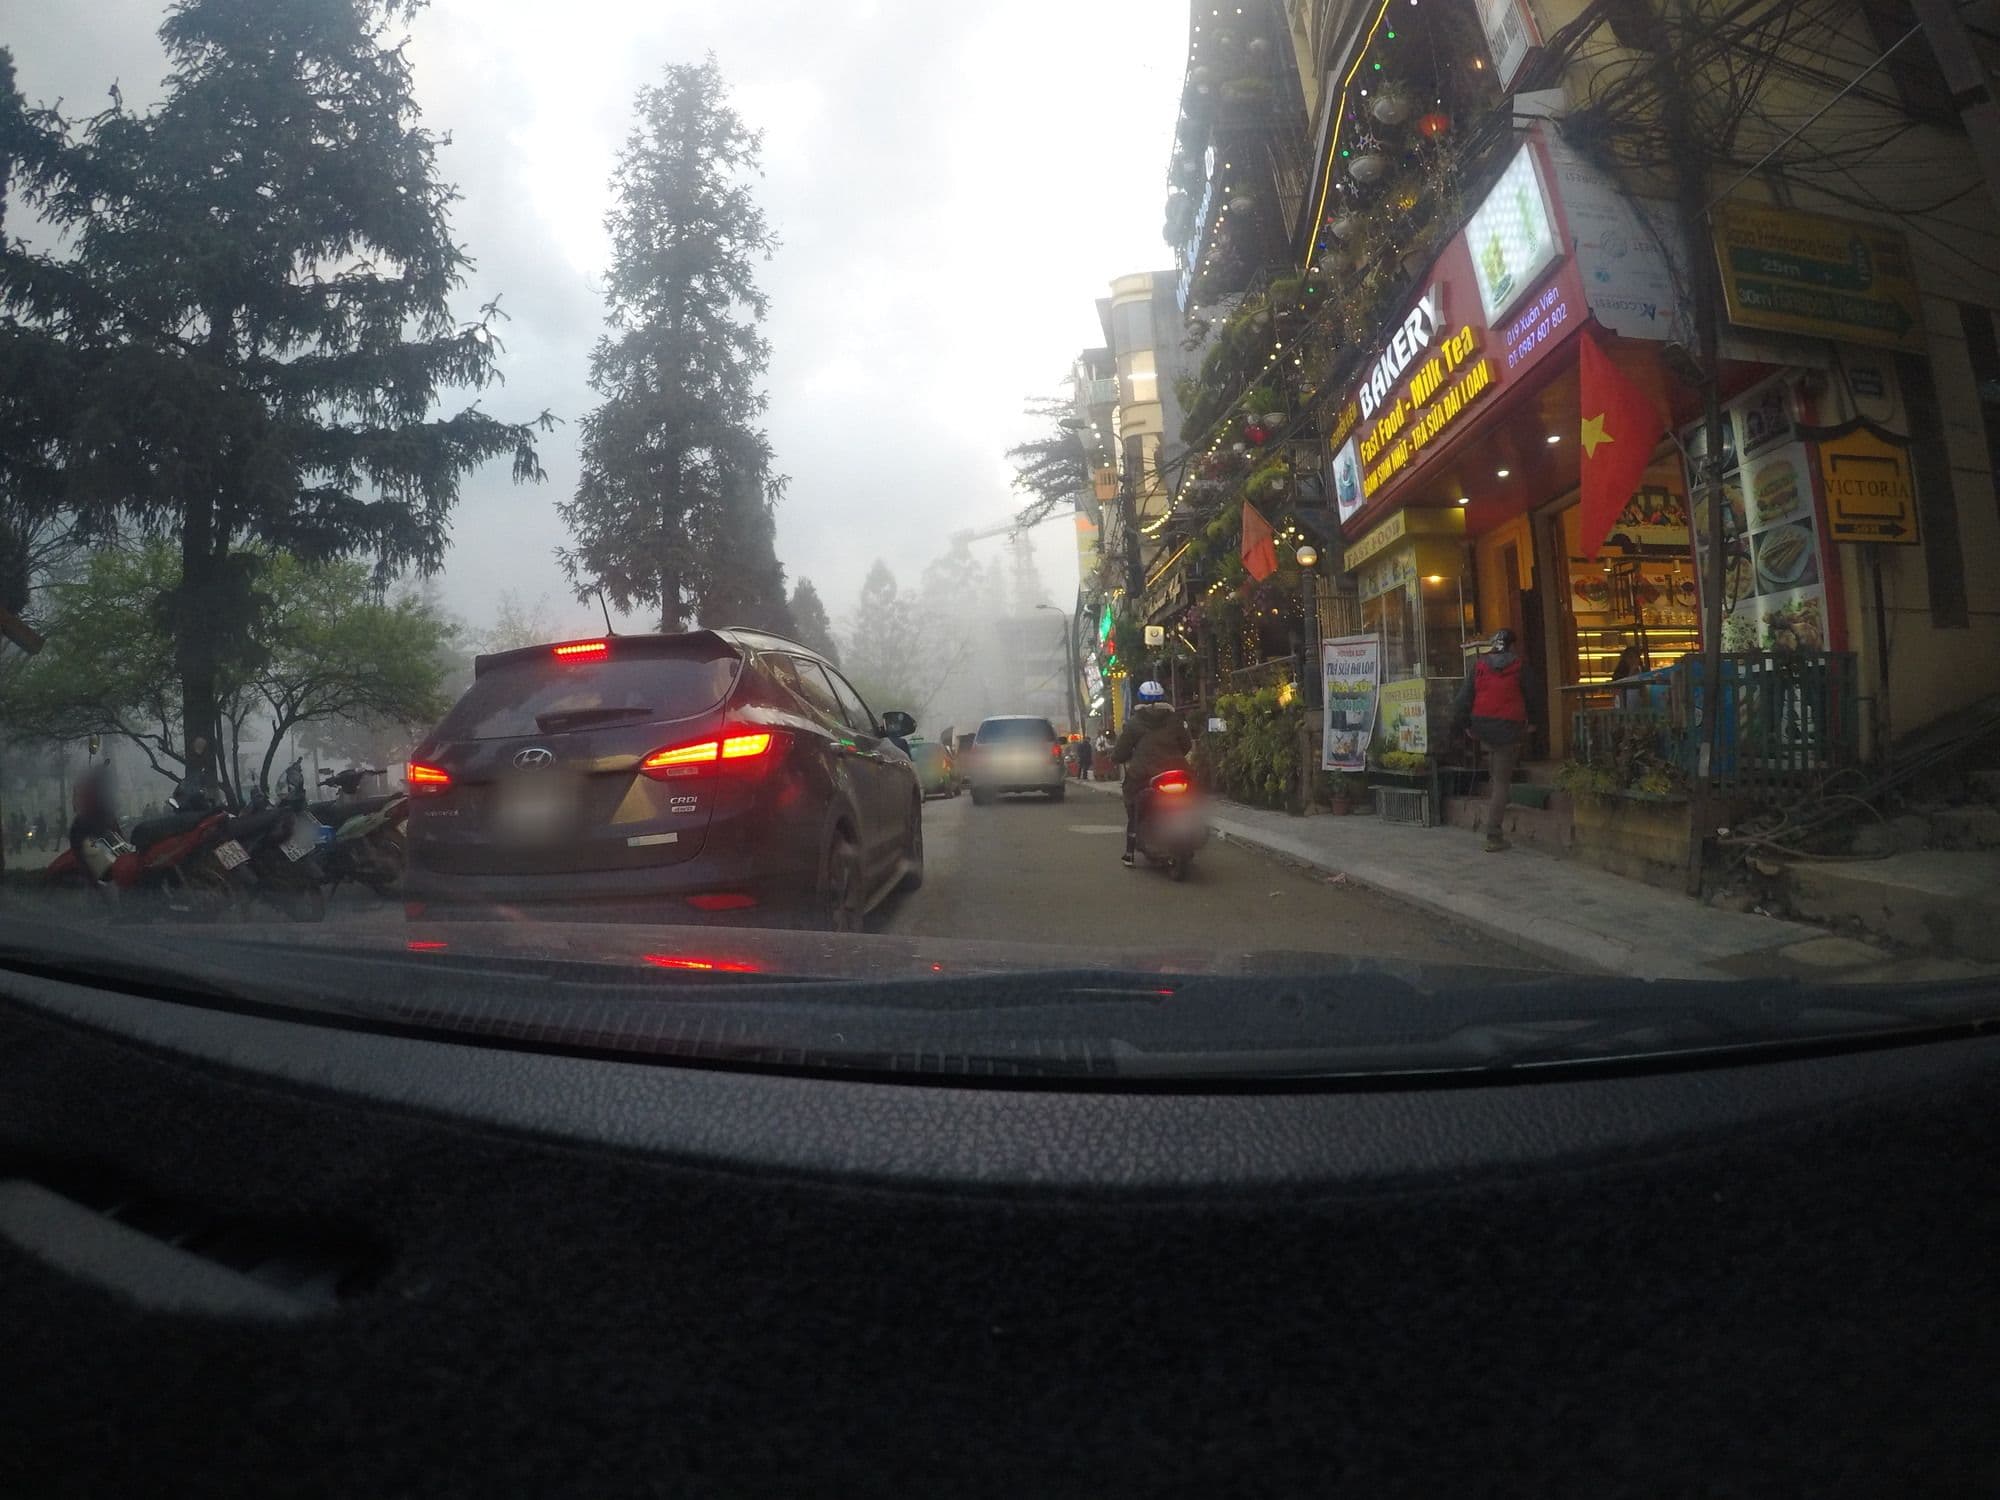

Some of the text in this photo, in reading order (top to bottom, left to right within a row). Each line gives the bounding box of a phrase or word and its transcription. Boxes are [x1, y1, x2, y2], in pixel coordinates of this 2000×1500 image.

[1359, 282, 1444, 420] BAKERY
[1506, 323, 1520, 346] 019
[1518, 331, 1535, 359] 0987
[1537, 317, 1550, 343] 607
[1551, 303, 1568, 328] 802
[1360, 428, 1380, 466] Fast
[1377, 398, 1405, 446] Food
[1409, 358, 1444, 410] Milk
[1441, 325, 1475, 373] Tea
[1411, 416, 1429, 451] TRÀ
[1426, 403, 1446, 438] SỮA
[1460, 358, 1489, 414] LOAN
[1825, 479, 1913, 497] VICTORIA
